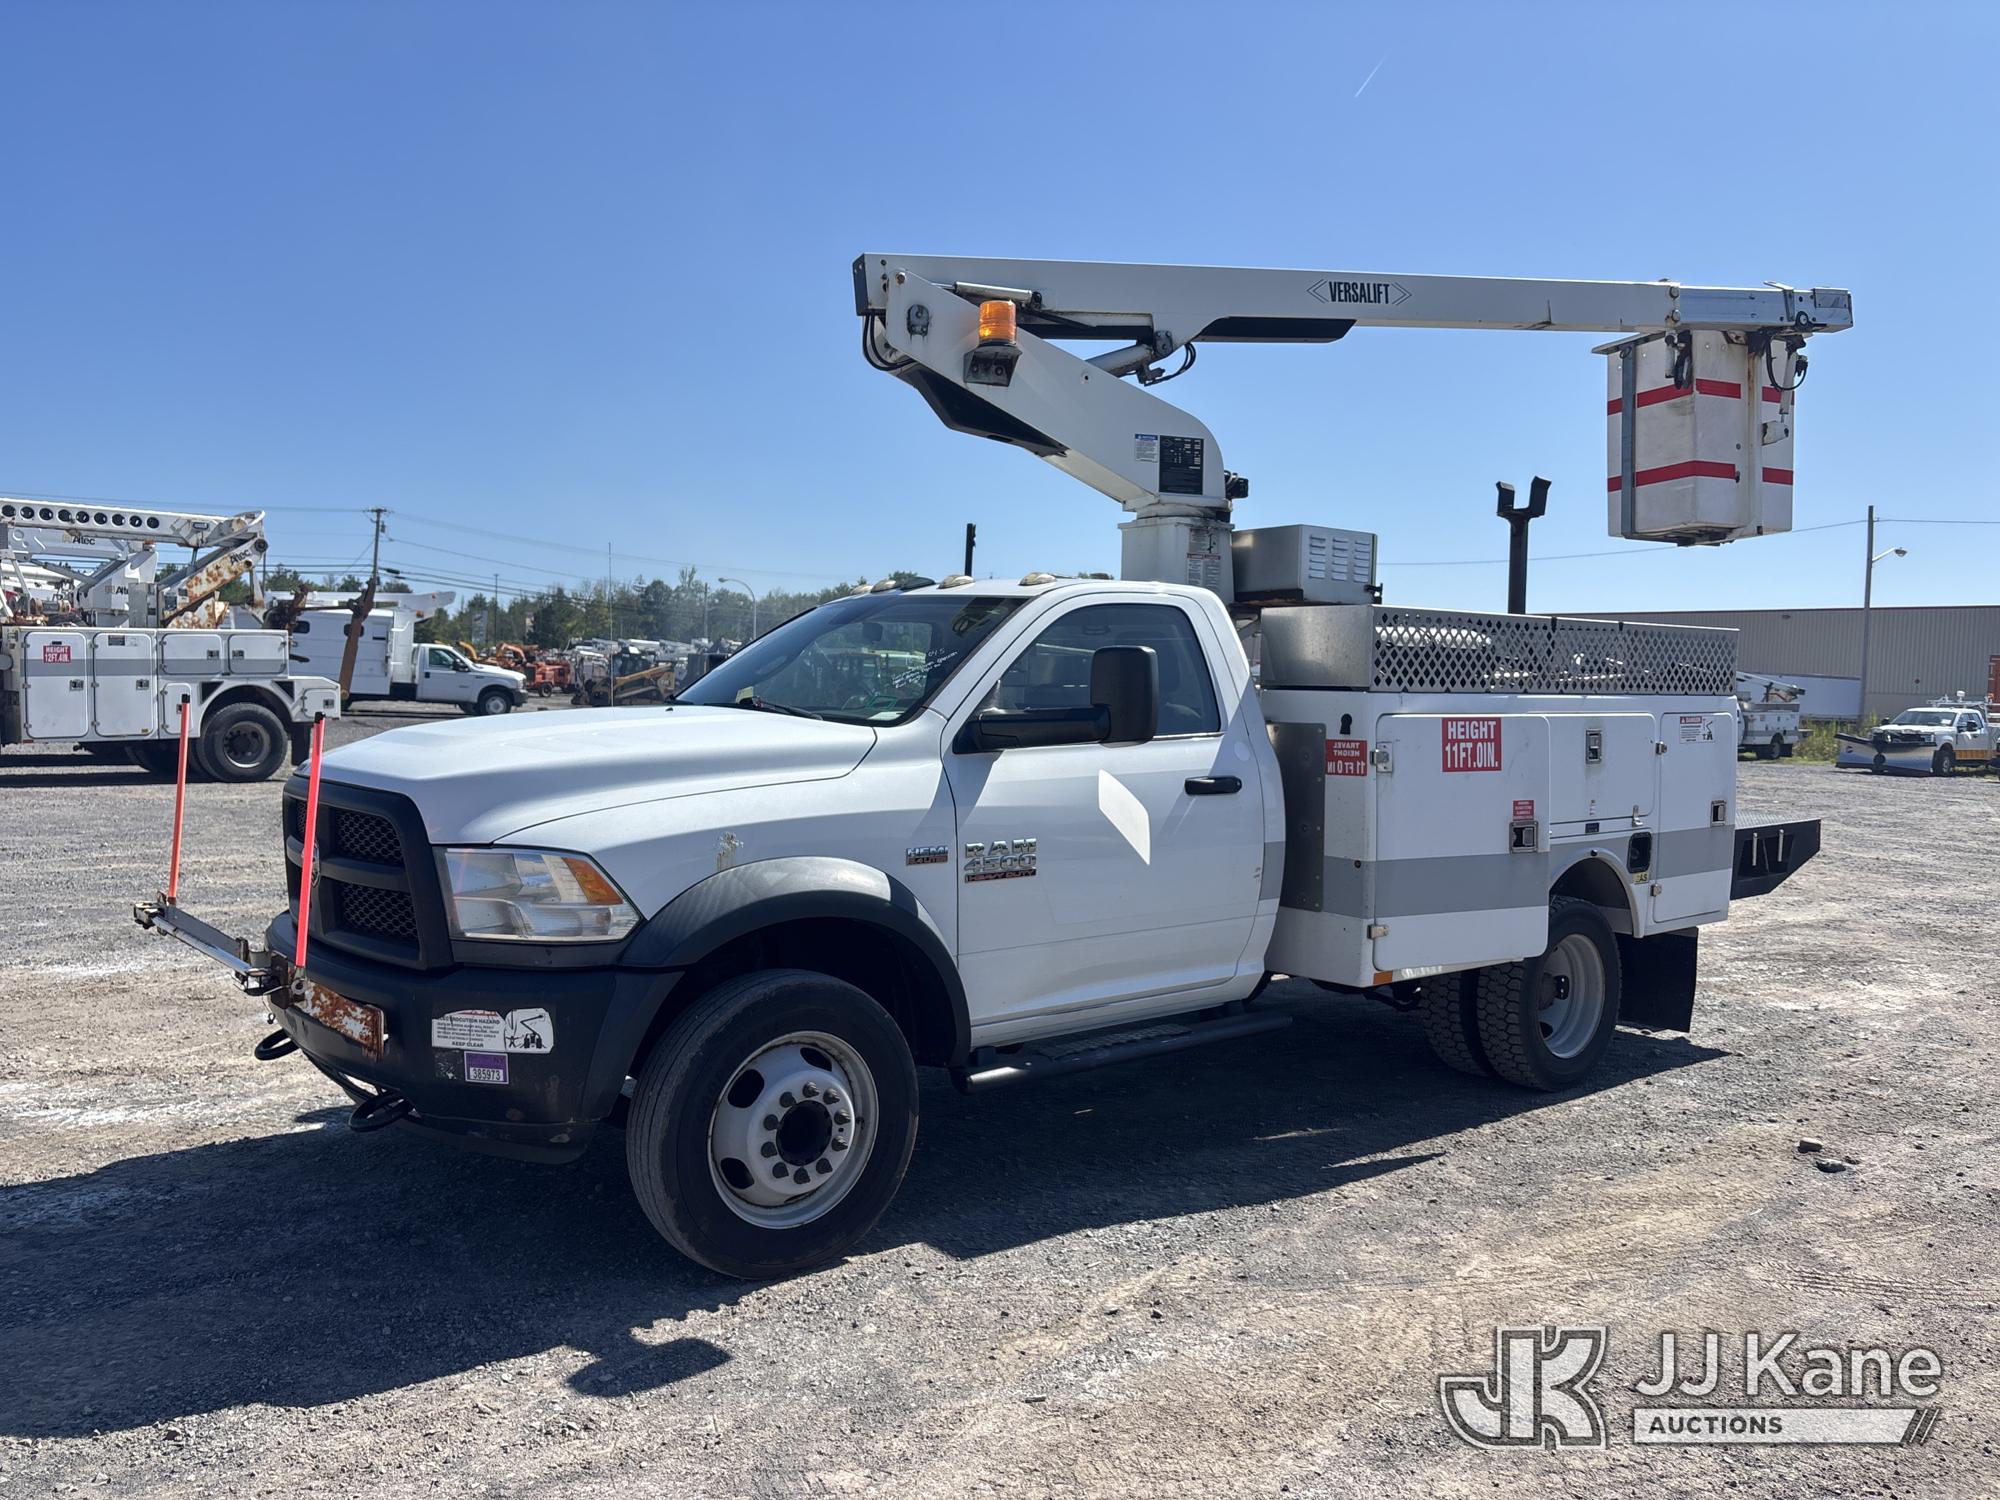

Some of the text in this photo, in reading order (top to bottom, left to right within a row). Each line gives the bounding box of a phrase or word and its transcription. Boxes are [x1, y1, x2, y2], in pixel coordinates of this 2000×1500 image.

[1328, 281, 1390, 304] VERSALIFT
[72, 535, 96, 546] Altec
[230, 549, 251, 566] Altec
[1447, 720, 1497, 739] HEIGHT
[906, 846, 949, 857] HEMI
[965, 838, 1037, 858] RAM
[964, 853, 1037, 872] 4500
[968, 869, 1035, 882] HEAVY DUTY
[472, 1068, 501, 1081] 385973
